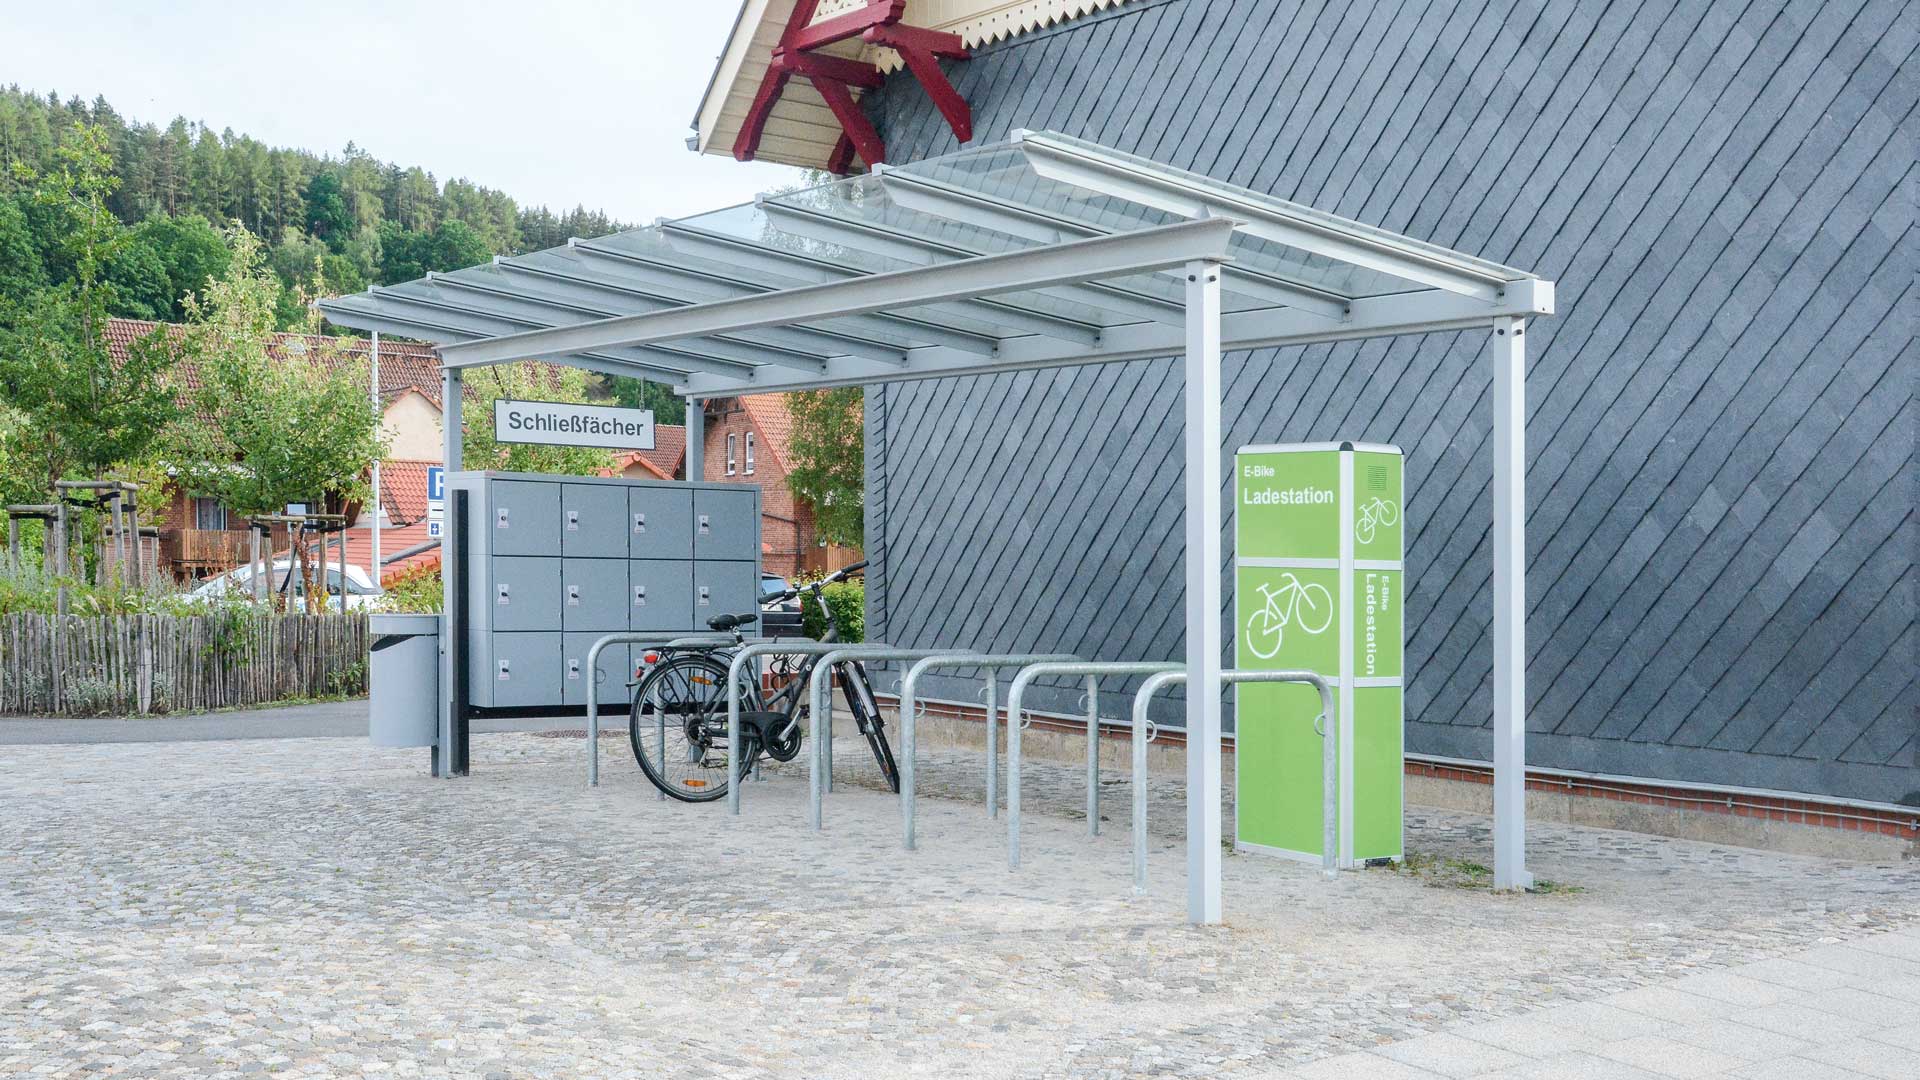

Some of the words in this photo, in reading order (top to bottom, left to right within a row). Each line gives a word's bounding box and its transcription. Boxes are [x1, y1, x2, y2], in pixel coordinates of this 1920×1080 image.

[508, 411, 644, 436] Schließfächer
[1244, 465, 1275, 478] E-Bike
[1243, 486, 1334, 505] Ladestation
[1382, 575, 1390, 611] E-Bike
[1365, 573, 1378, 675] Ladestation
